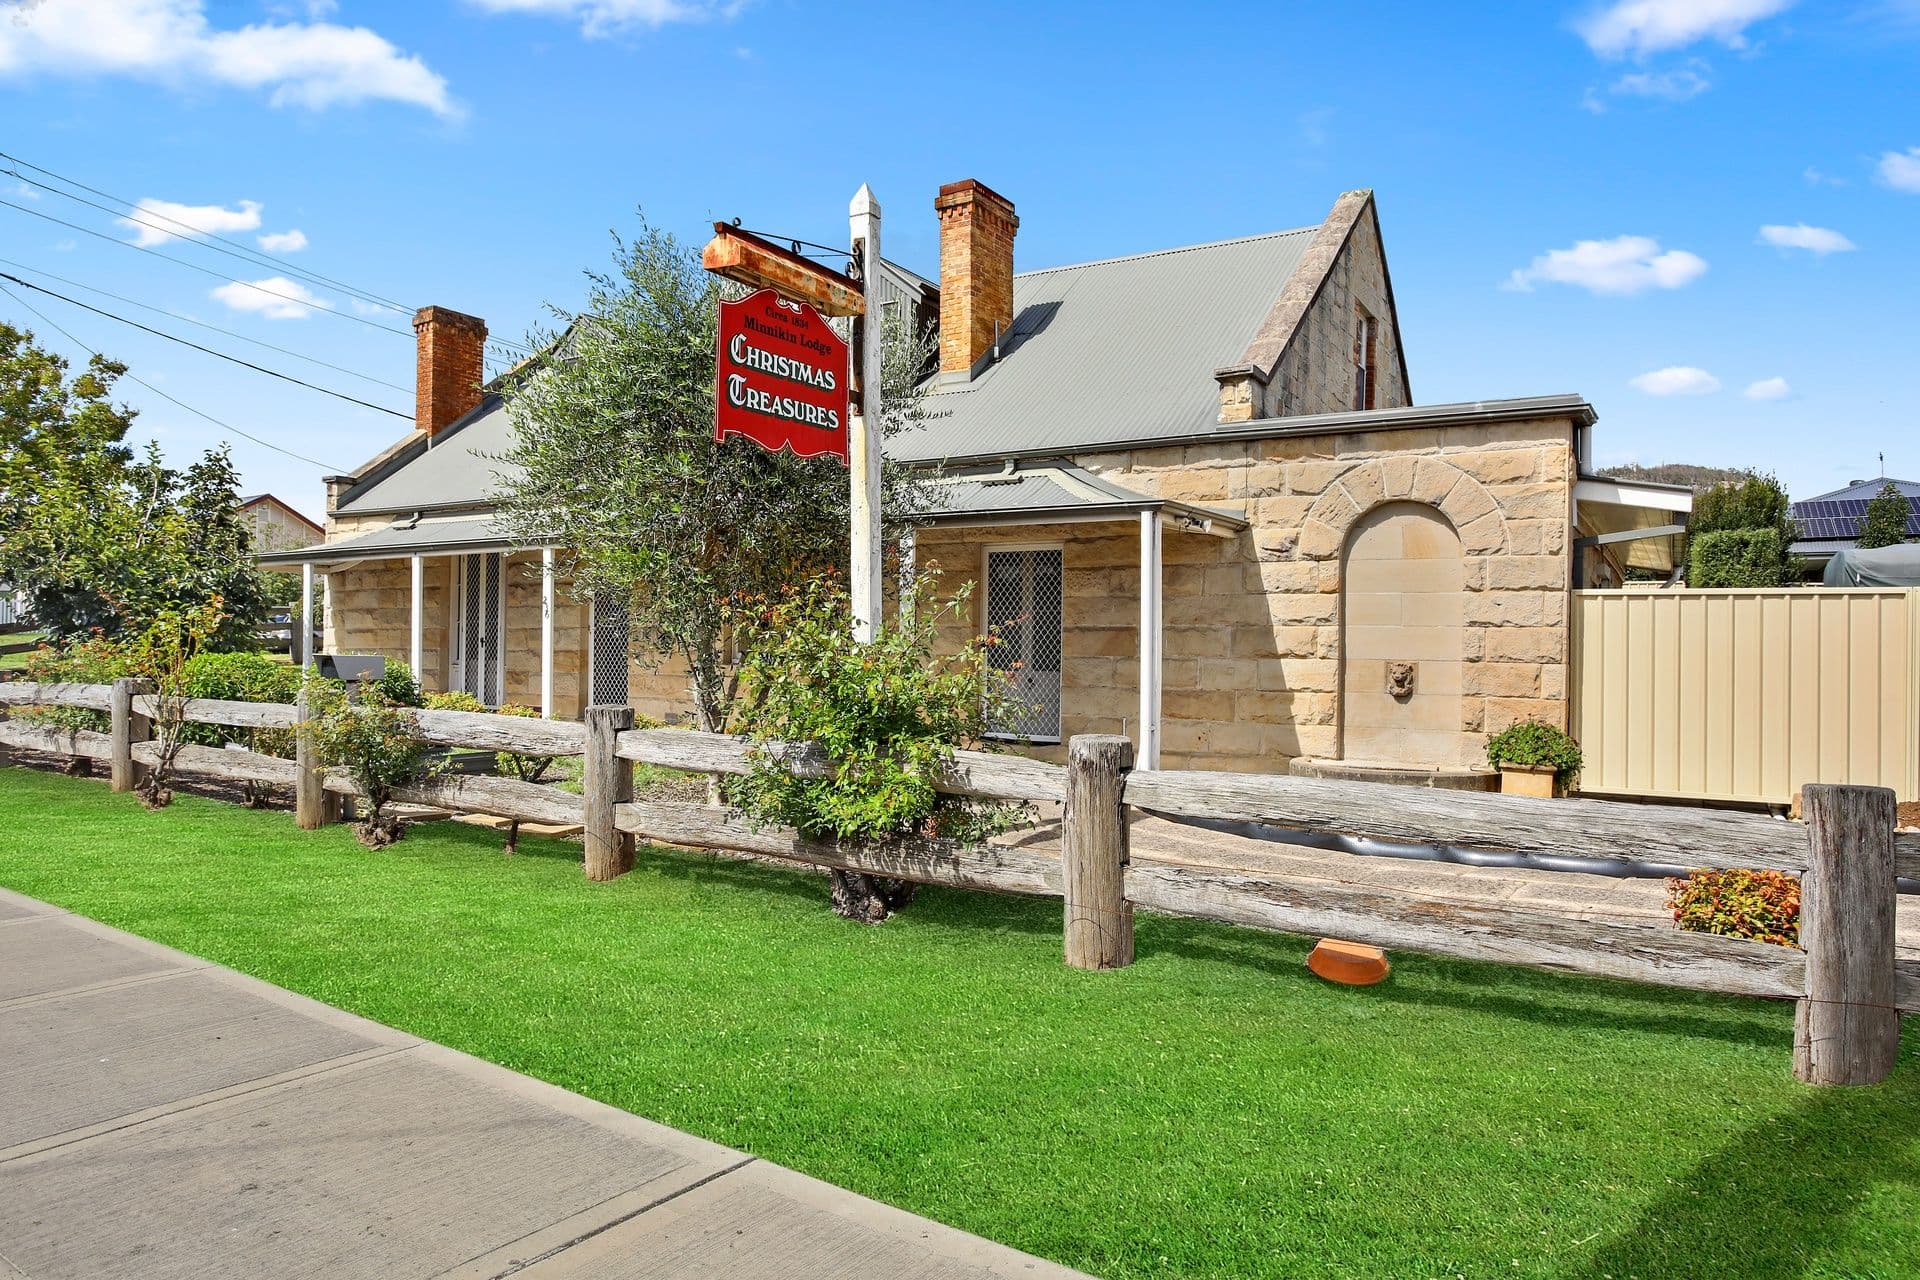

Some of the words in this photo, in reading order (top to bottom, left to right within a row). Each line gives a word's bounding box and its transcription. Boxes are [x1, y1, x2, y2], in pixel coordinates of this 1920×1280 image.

[744, 315, 797, 345] Minnikin
[800, 334, 832, 356] Lodge
[765, 306, 788, 323] Circa
[730, 333, 836, 391] CHRISTMAS
[728, 373, 840, 429] TREASURES
